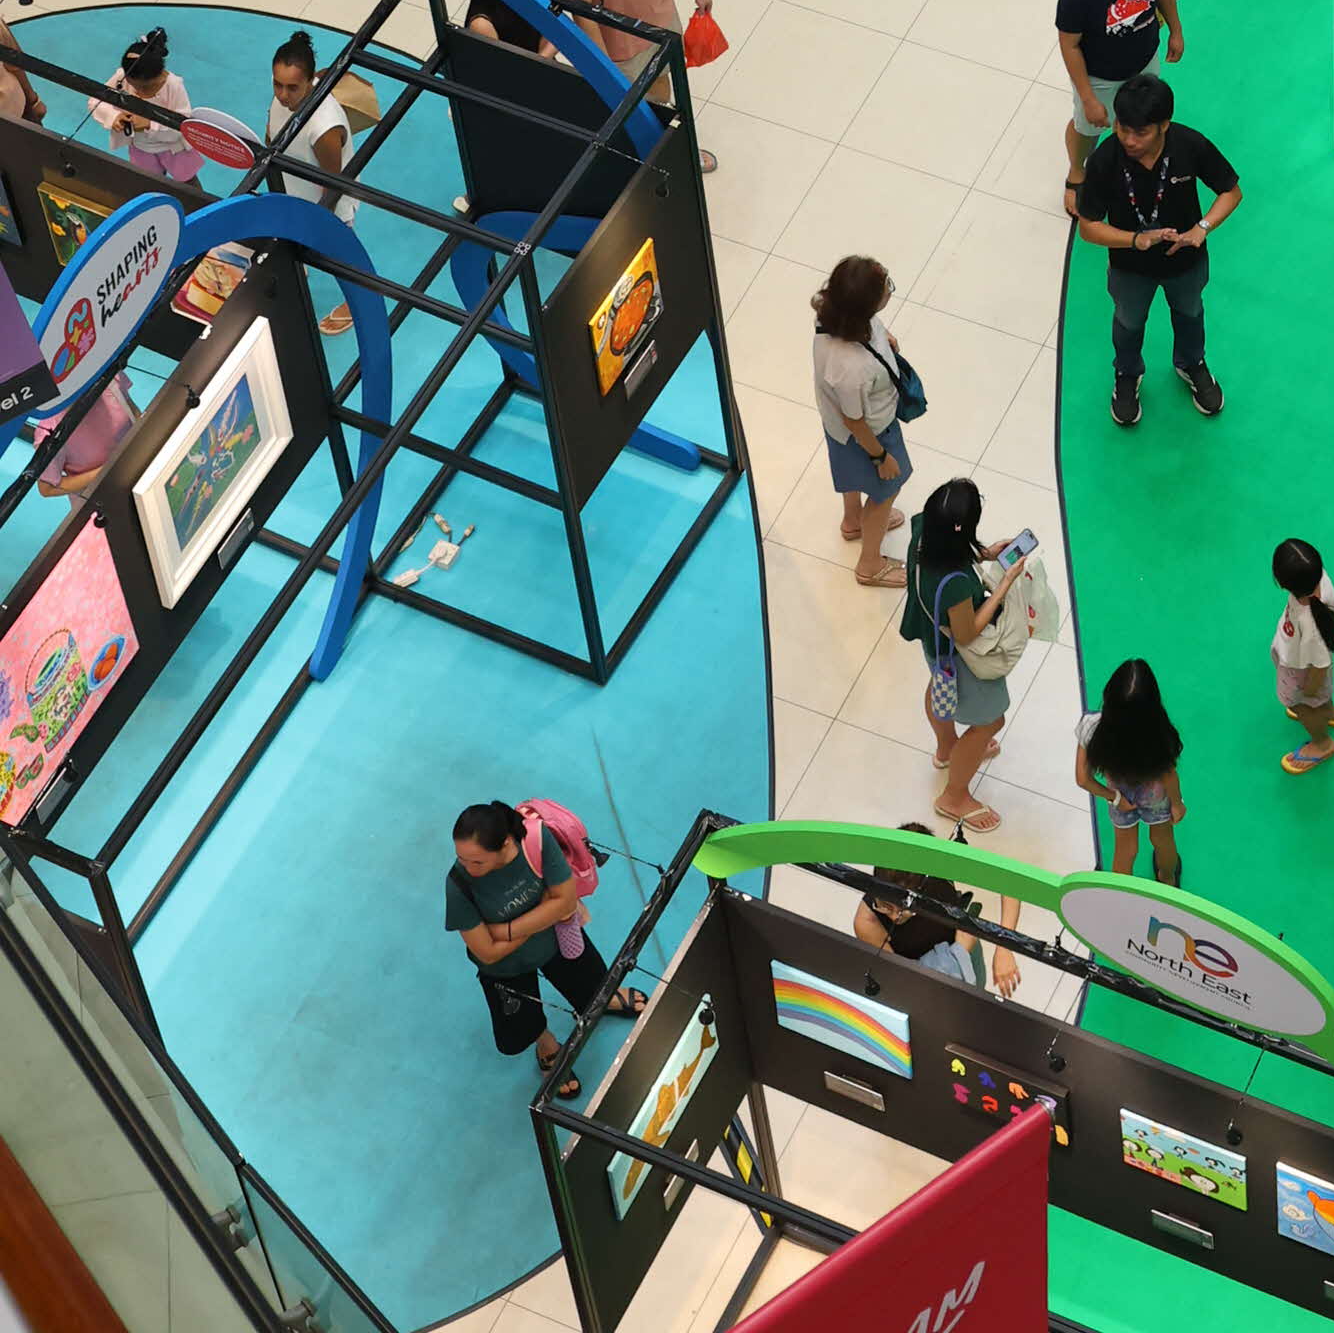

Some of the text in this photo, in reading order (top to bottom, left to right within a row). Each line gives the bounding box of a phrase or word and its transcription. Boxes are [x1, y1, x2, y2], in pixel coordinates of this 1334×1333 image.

[185, 123, 219, 143] SECURITY
[96, 224, 159, 306] SHAPING
[100, 245, 163, 329] hearts
[1126, 937, 1252, 1006] North East
[1146, 915, 1240, 979] ne
